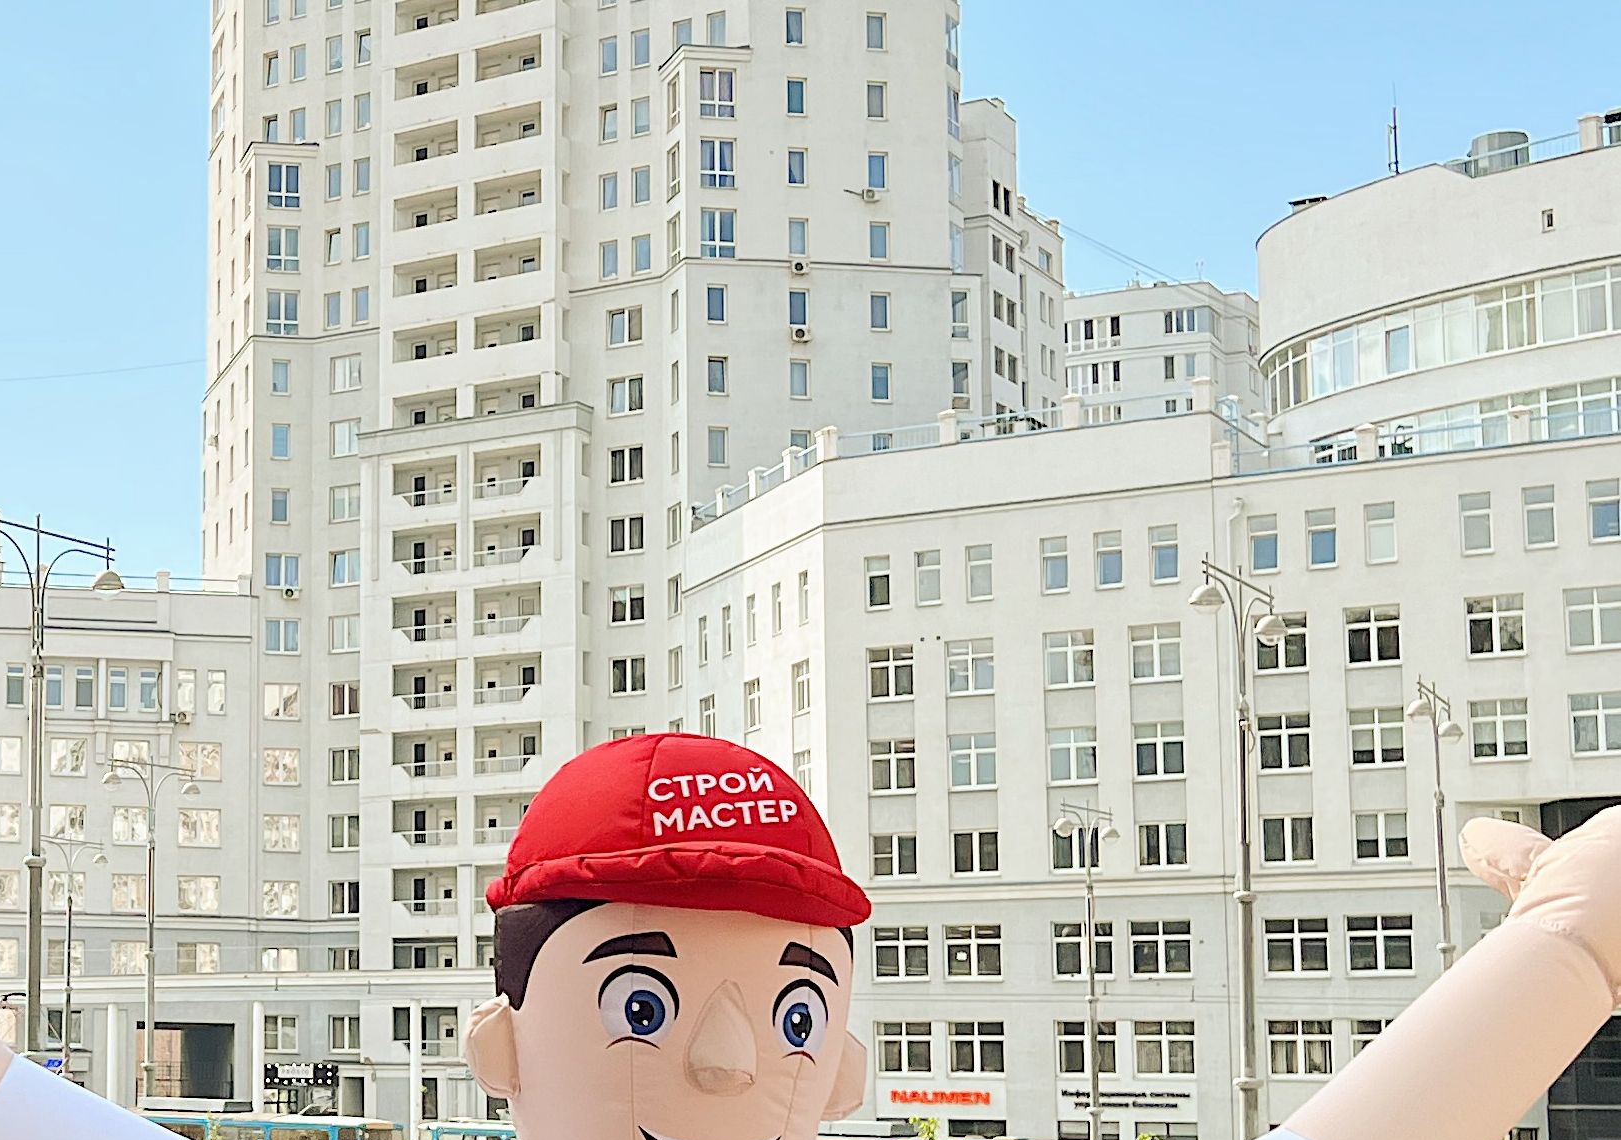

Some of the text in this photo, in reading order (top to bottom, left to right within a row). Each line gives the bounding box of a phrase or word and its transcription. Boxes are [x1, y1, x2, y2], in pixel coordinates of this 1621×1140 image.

[647, 767, 774, 802] СТРОЙ
[652, 799, 798, 837] МАСТЕР
[890, 1089, 992, 1106] NAUMEN
